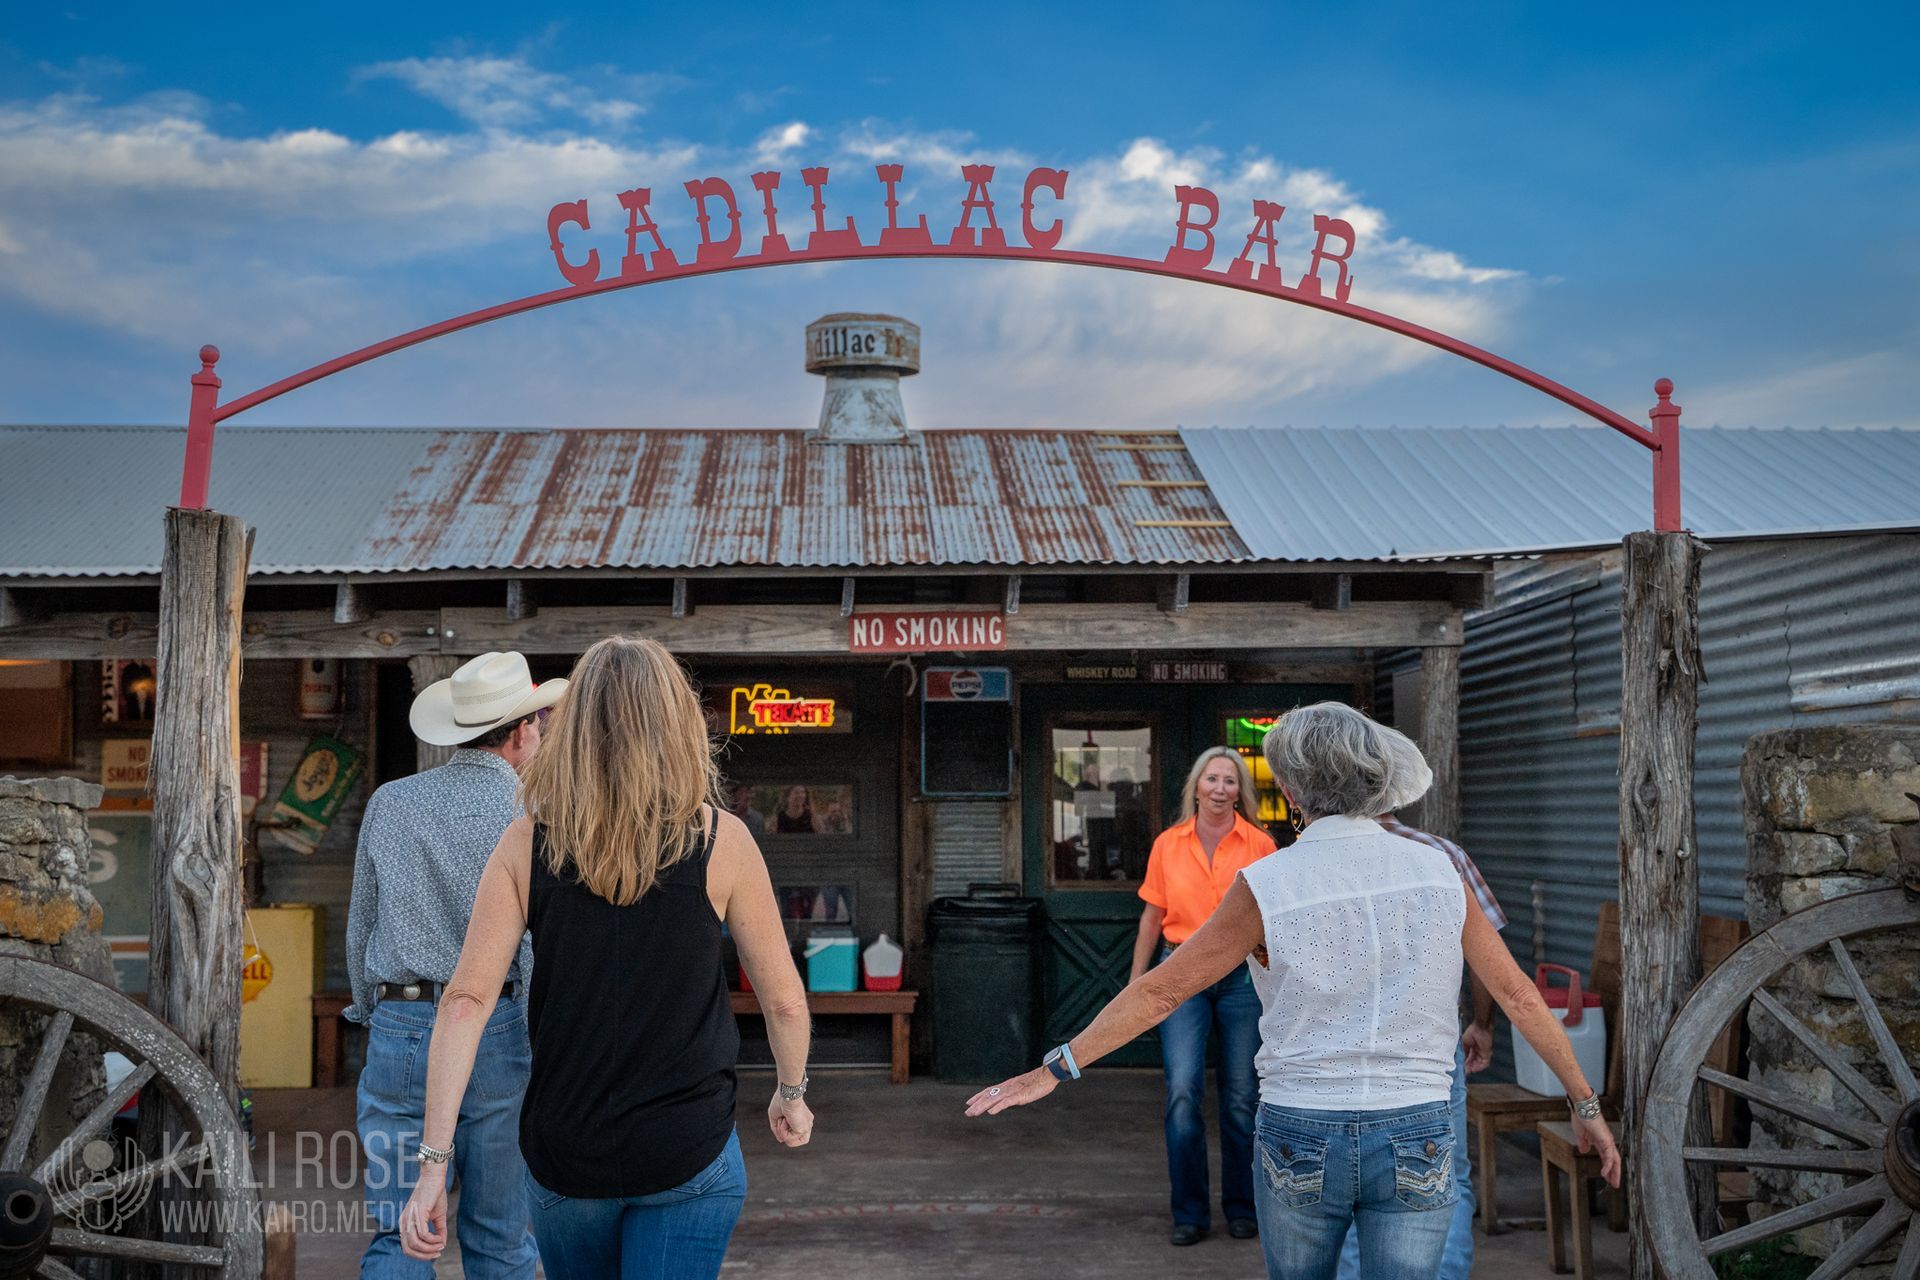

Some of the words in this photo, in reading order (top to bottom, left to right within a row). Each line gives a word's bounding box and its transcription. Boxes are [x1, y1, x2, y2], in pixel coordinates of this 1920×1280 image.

[547, 164, 1069, 285] CADILLAC
[1164, 185, 1355, 303] BAR
[816, 327, 875, 357] dillac
[853, 618, 884, 647] NO
[895, 616, 1001, 646] SMOKING
[1067, 667, 1109, 679] WHISKEY
[1112, 667, 1137, 679] ROAD
[1154, 664, 1169, 680] NO
[1174, 664, 1225, 680] SMOKING
[128, 747, 147, 761] NO
[107, 766, 148, 782] SMOK
[243, 963, 268, 980] ELL
